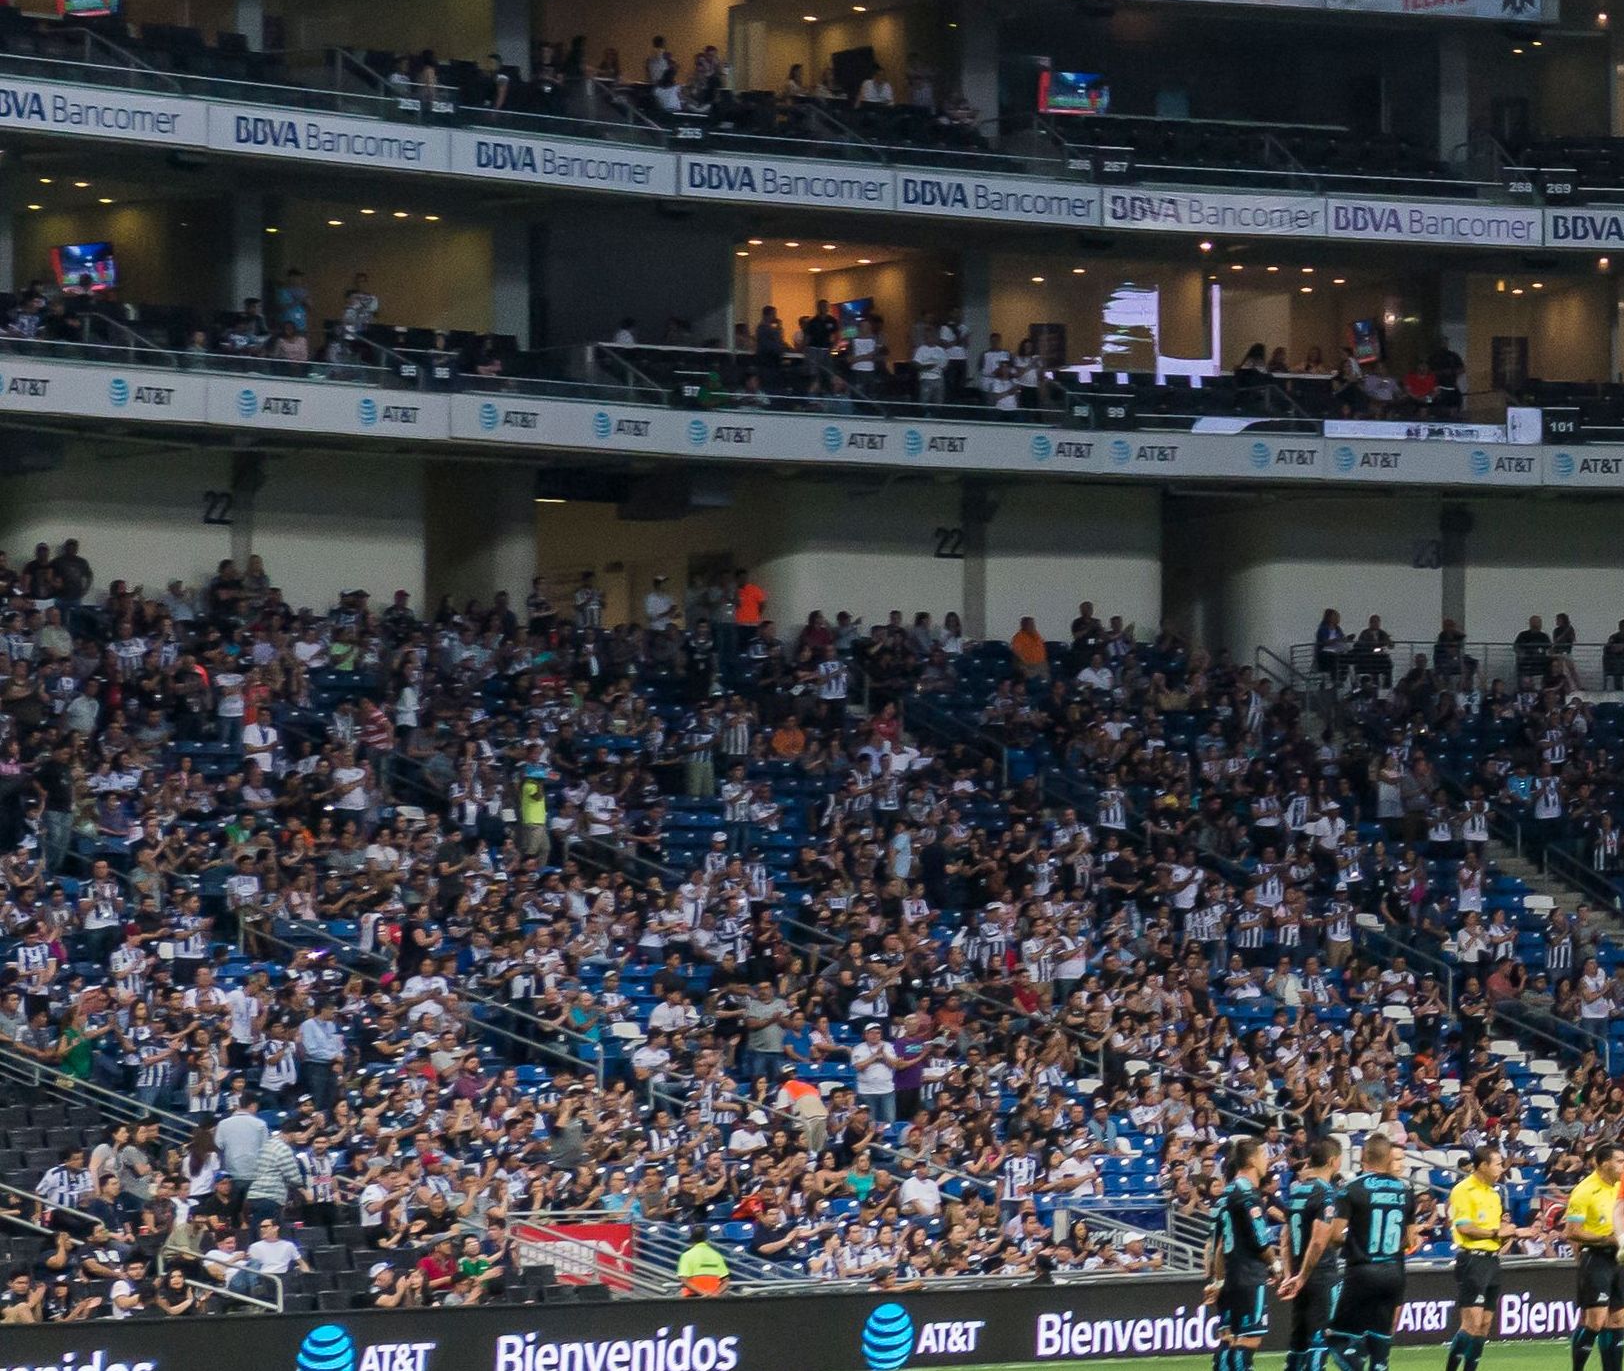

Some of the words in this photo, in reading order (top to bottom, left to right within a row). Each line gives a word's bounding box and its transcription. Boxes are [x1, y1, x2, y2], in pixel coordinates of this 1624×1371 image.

[236, 116, 300, 148] BBVA
[305, 121, 426, 164] Bancomer
[689, 162, 756, 192] BBVA
[761, 167, 890, 204] Bancomer
[904, 179, 968, 208] BBVA
[974, 184, 1096, 220] Bancomer
[1553, 216, 1624, 240] BBVA
[135, 387, 174, 405] AT&T
[503, 411, 539, 428] AT&T
[929, 437, 967, 452] AT&T
[1360, 453, 1401, 468] AT&T
[204, 491, 232, 524] 22
[1369, 1208, 1403, 1255] 16
[1397, 1300, 1454, 1332] AT&T
[496, 1324, 738, 1371] Bienvenidos
[916, 1321, 982, 1355] AT&T
[361, 1343, 436, 1371] AT&T
